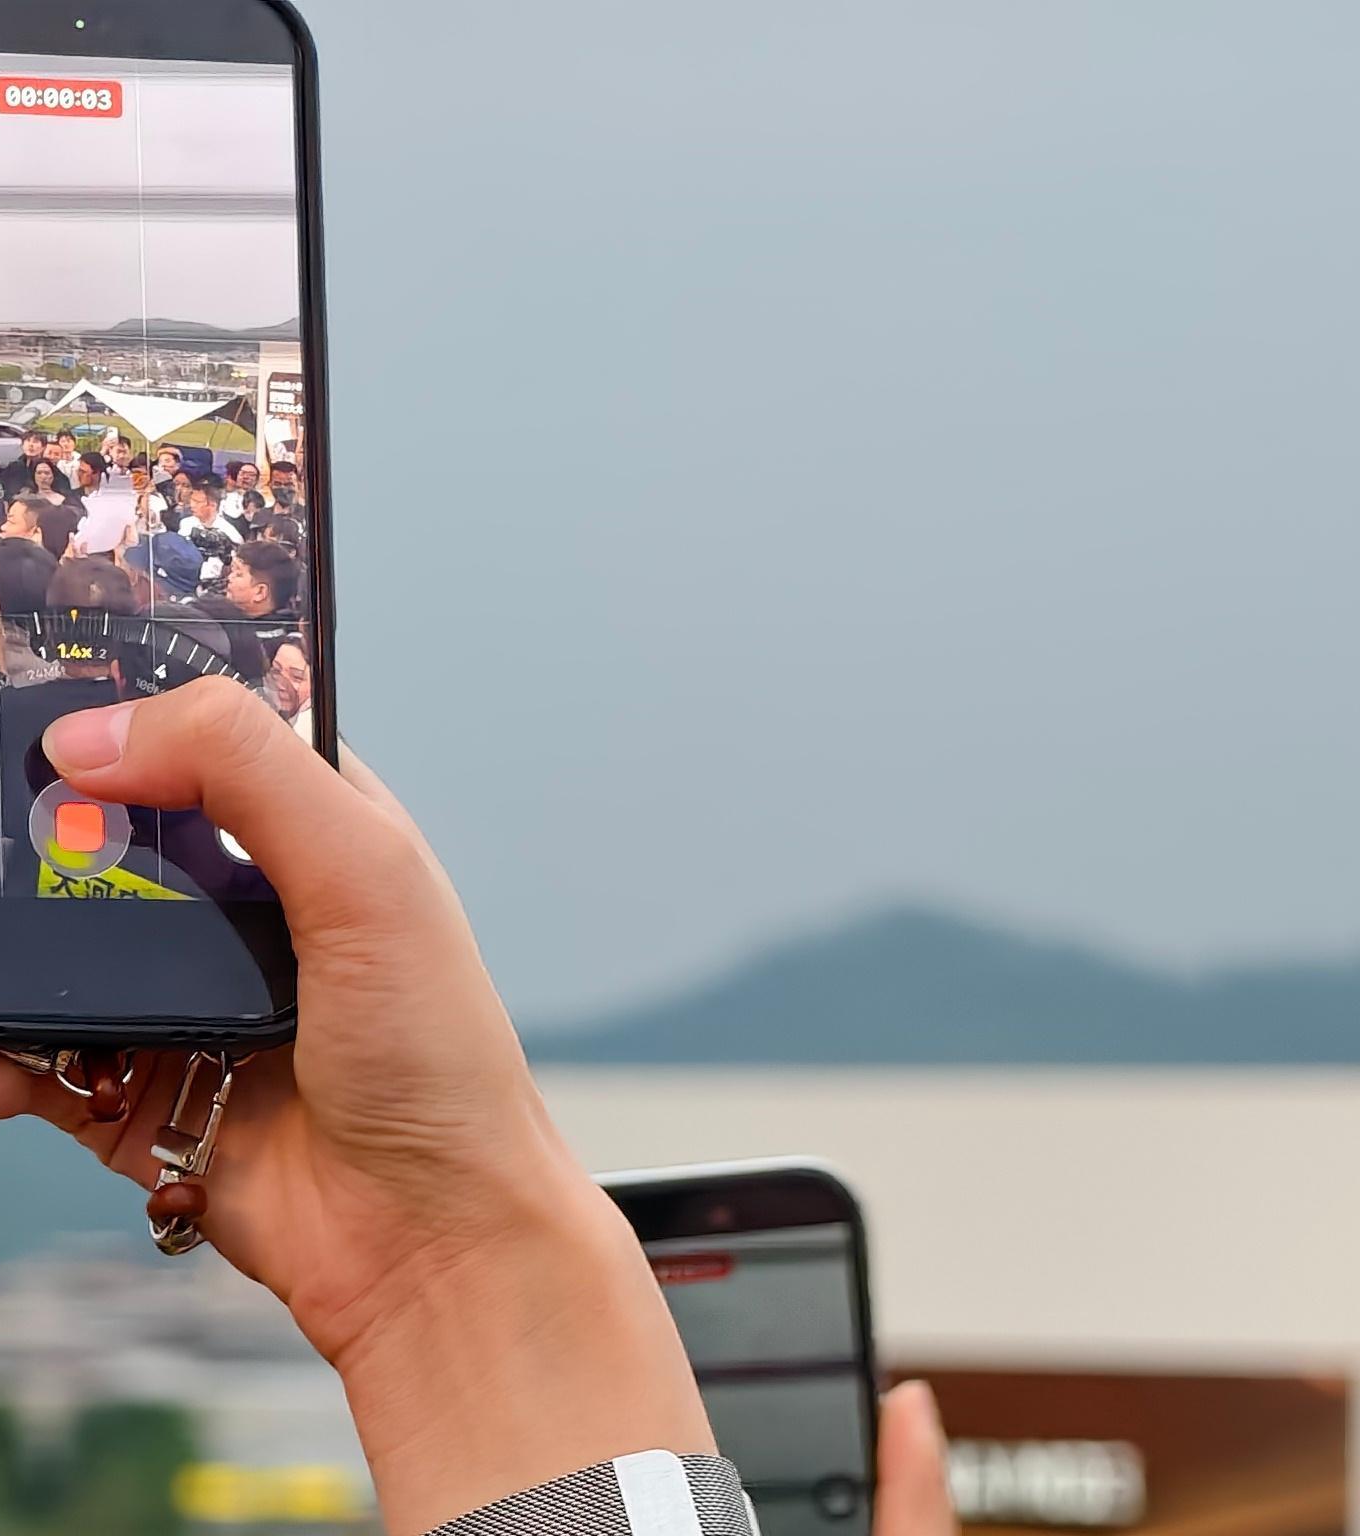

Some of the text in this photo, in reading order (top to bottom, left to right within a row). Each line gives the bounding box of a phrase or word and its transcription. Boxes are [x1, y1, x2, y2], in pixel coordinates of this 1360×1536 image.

[5, 85, 112, 110] 00:00:03
[57, 642, 92, 659] 1.4x
[99, 648, 107, 659] 2
